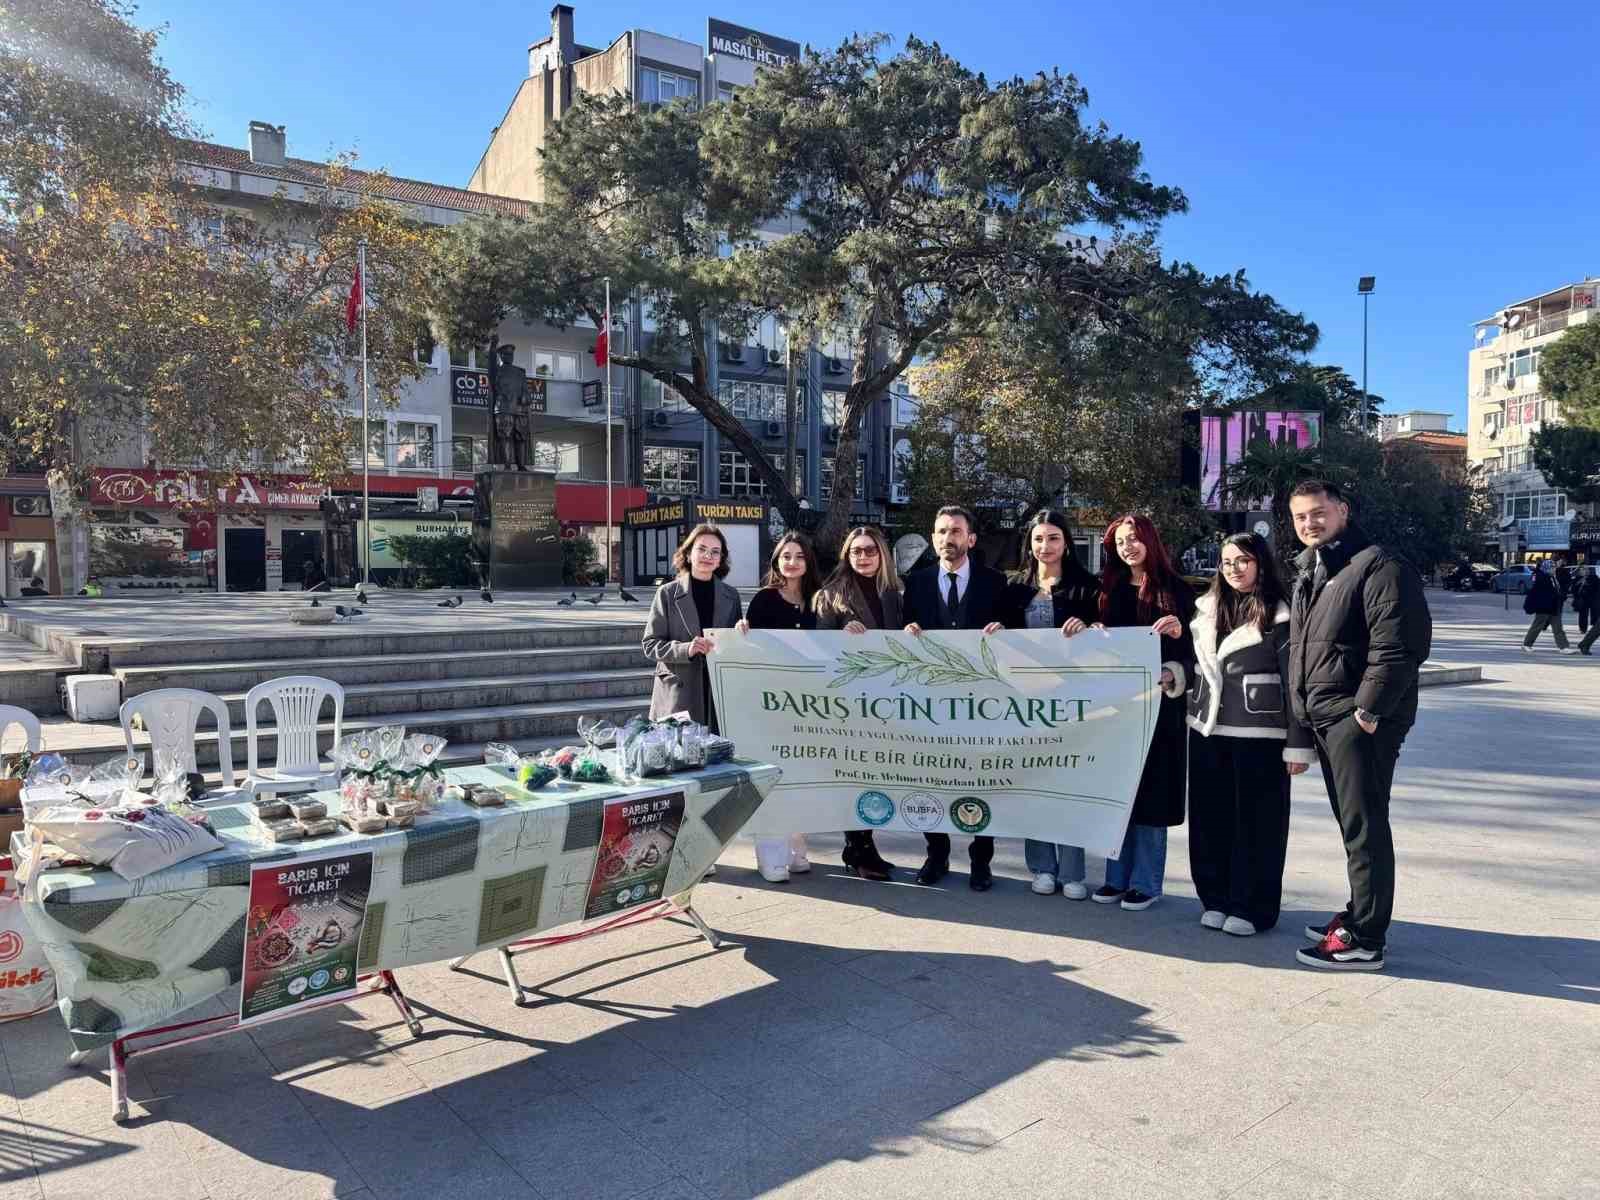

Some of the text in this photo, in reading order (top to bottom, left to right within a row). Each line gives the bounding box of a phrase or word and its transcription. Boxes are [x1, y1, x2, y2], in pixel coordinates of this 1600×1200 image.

[712, 36, 754, 60] MASAL
[735, 504, 763, 519] TAKSİ
[762, 690, 1092, 728] BARIŞ İÇİN TİCARET
[772, 744, 838, 760] "BUBFA
[844, 745, 868, 762] İLE
[875, 749, 906, 765] BİR
[912, 751, 973, 771] ÜRÜN,
[981, 754, 1014, 770] BİR
[1022, 754, 1080, 769] UMUT
[835, 768, 861, 778] Prof.
[862, 771, 879, 781] Dr.
[881, 772, 923, 784] Mehmet
[925, 776, 975, 788] Oğuzhan
[905, 805, 939, 815] BUBFA
